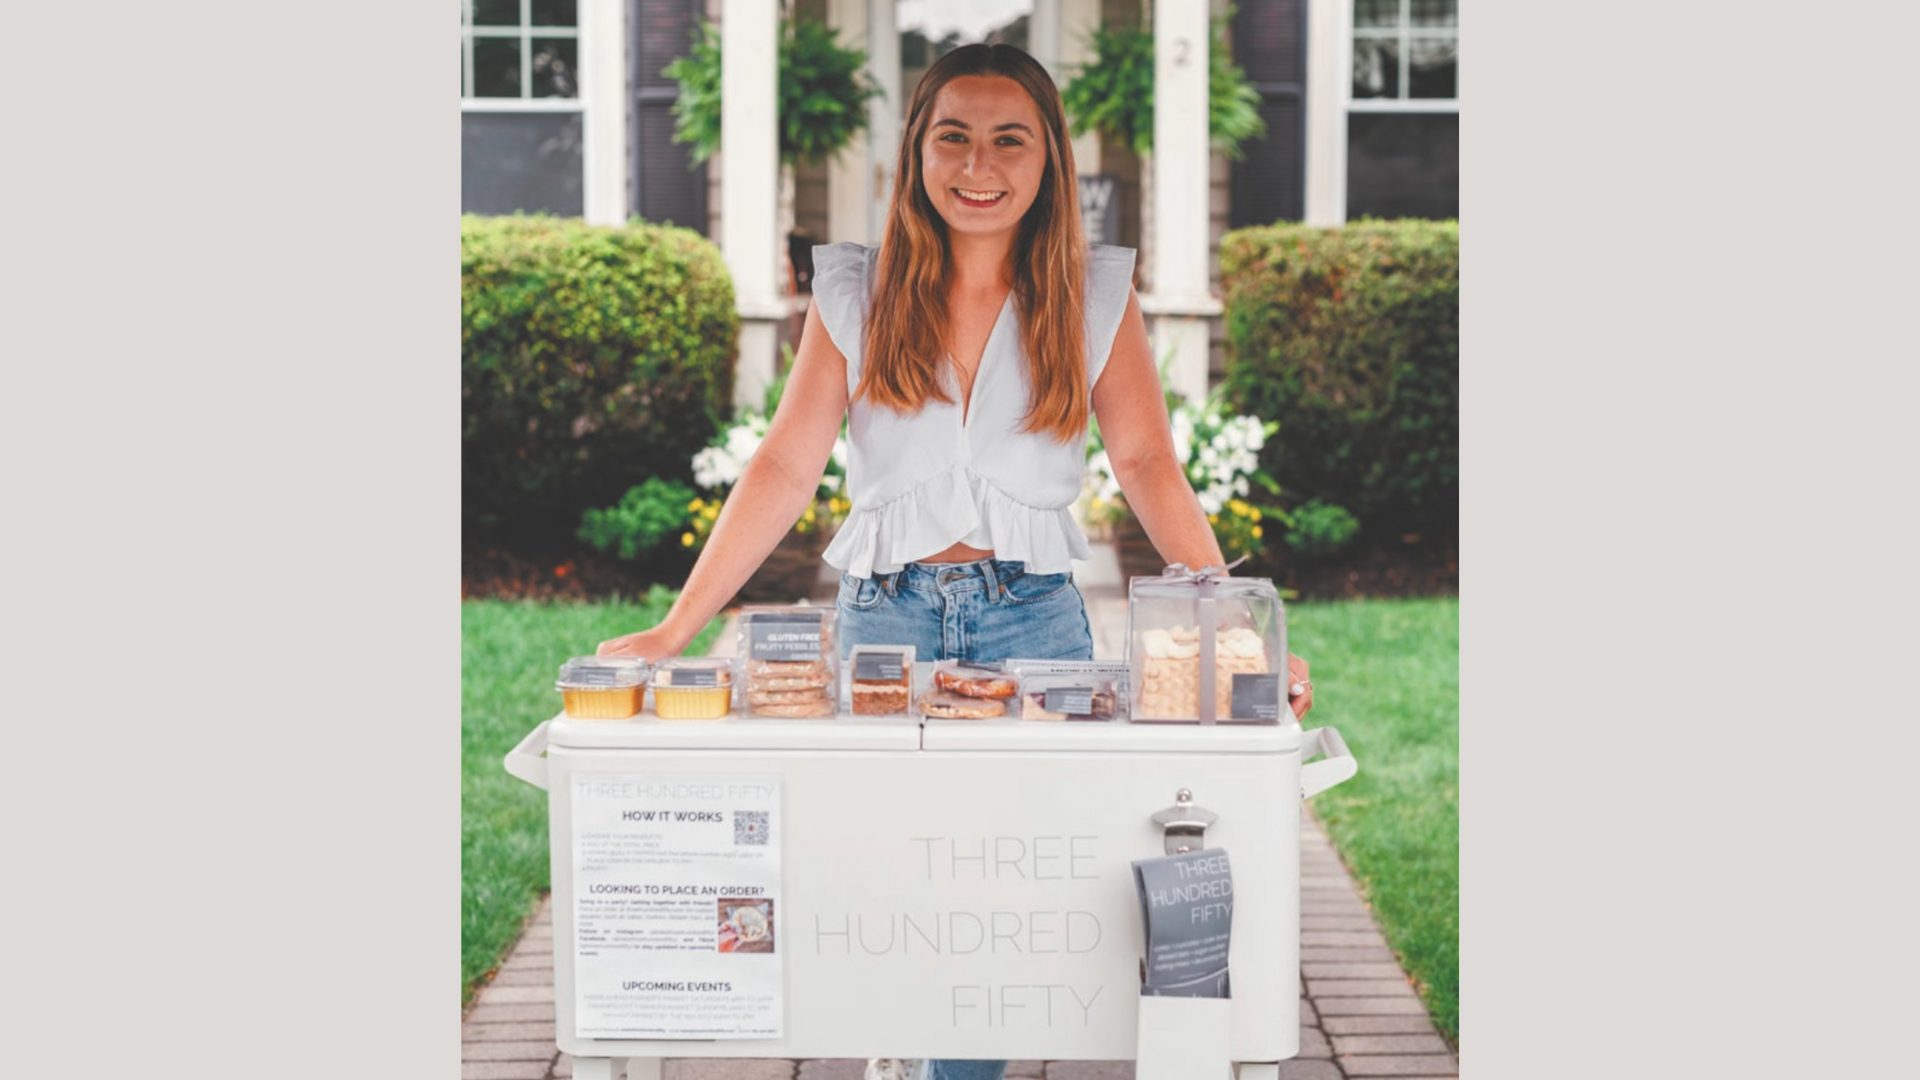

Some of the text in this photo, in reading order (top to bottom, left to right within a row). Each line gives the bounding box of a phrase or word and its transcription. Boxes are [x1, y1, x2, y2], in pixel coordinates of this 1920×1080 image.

[1174, 37, 1191, 68] 2
[755, 643, 783, 652] FRUITY
[767, 633, 820, 642] GLUTEN FREE
[577, 783, 775, 800] THREE HUNDRED FIFTY
[622, 811, 723, 823] HOW IT WORKS
[910, 835, 1101, 881] THREE
[1174, 855, 1230, 879] THREE
[590, 884, 764, 896] LOOKING TO PLACE AN ORDER?
[1150, 878, 1233, 908] HUNDRED
[1190, 902, 1232, 925] FIFTY
[815, 910, 1102, 956] HUNDRED
[622, 981, 732, 992] UPCOMING EVENTS
[952, 984, 1103, 1028] FIFTY
